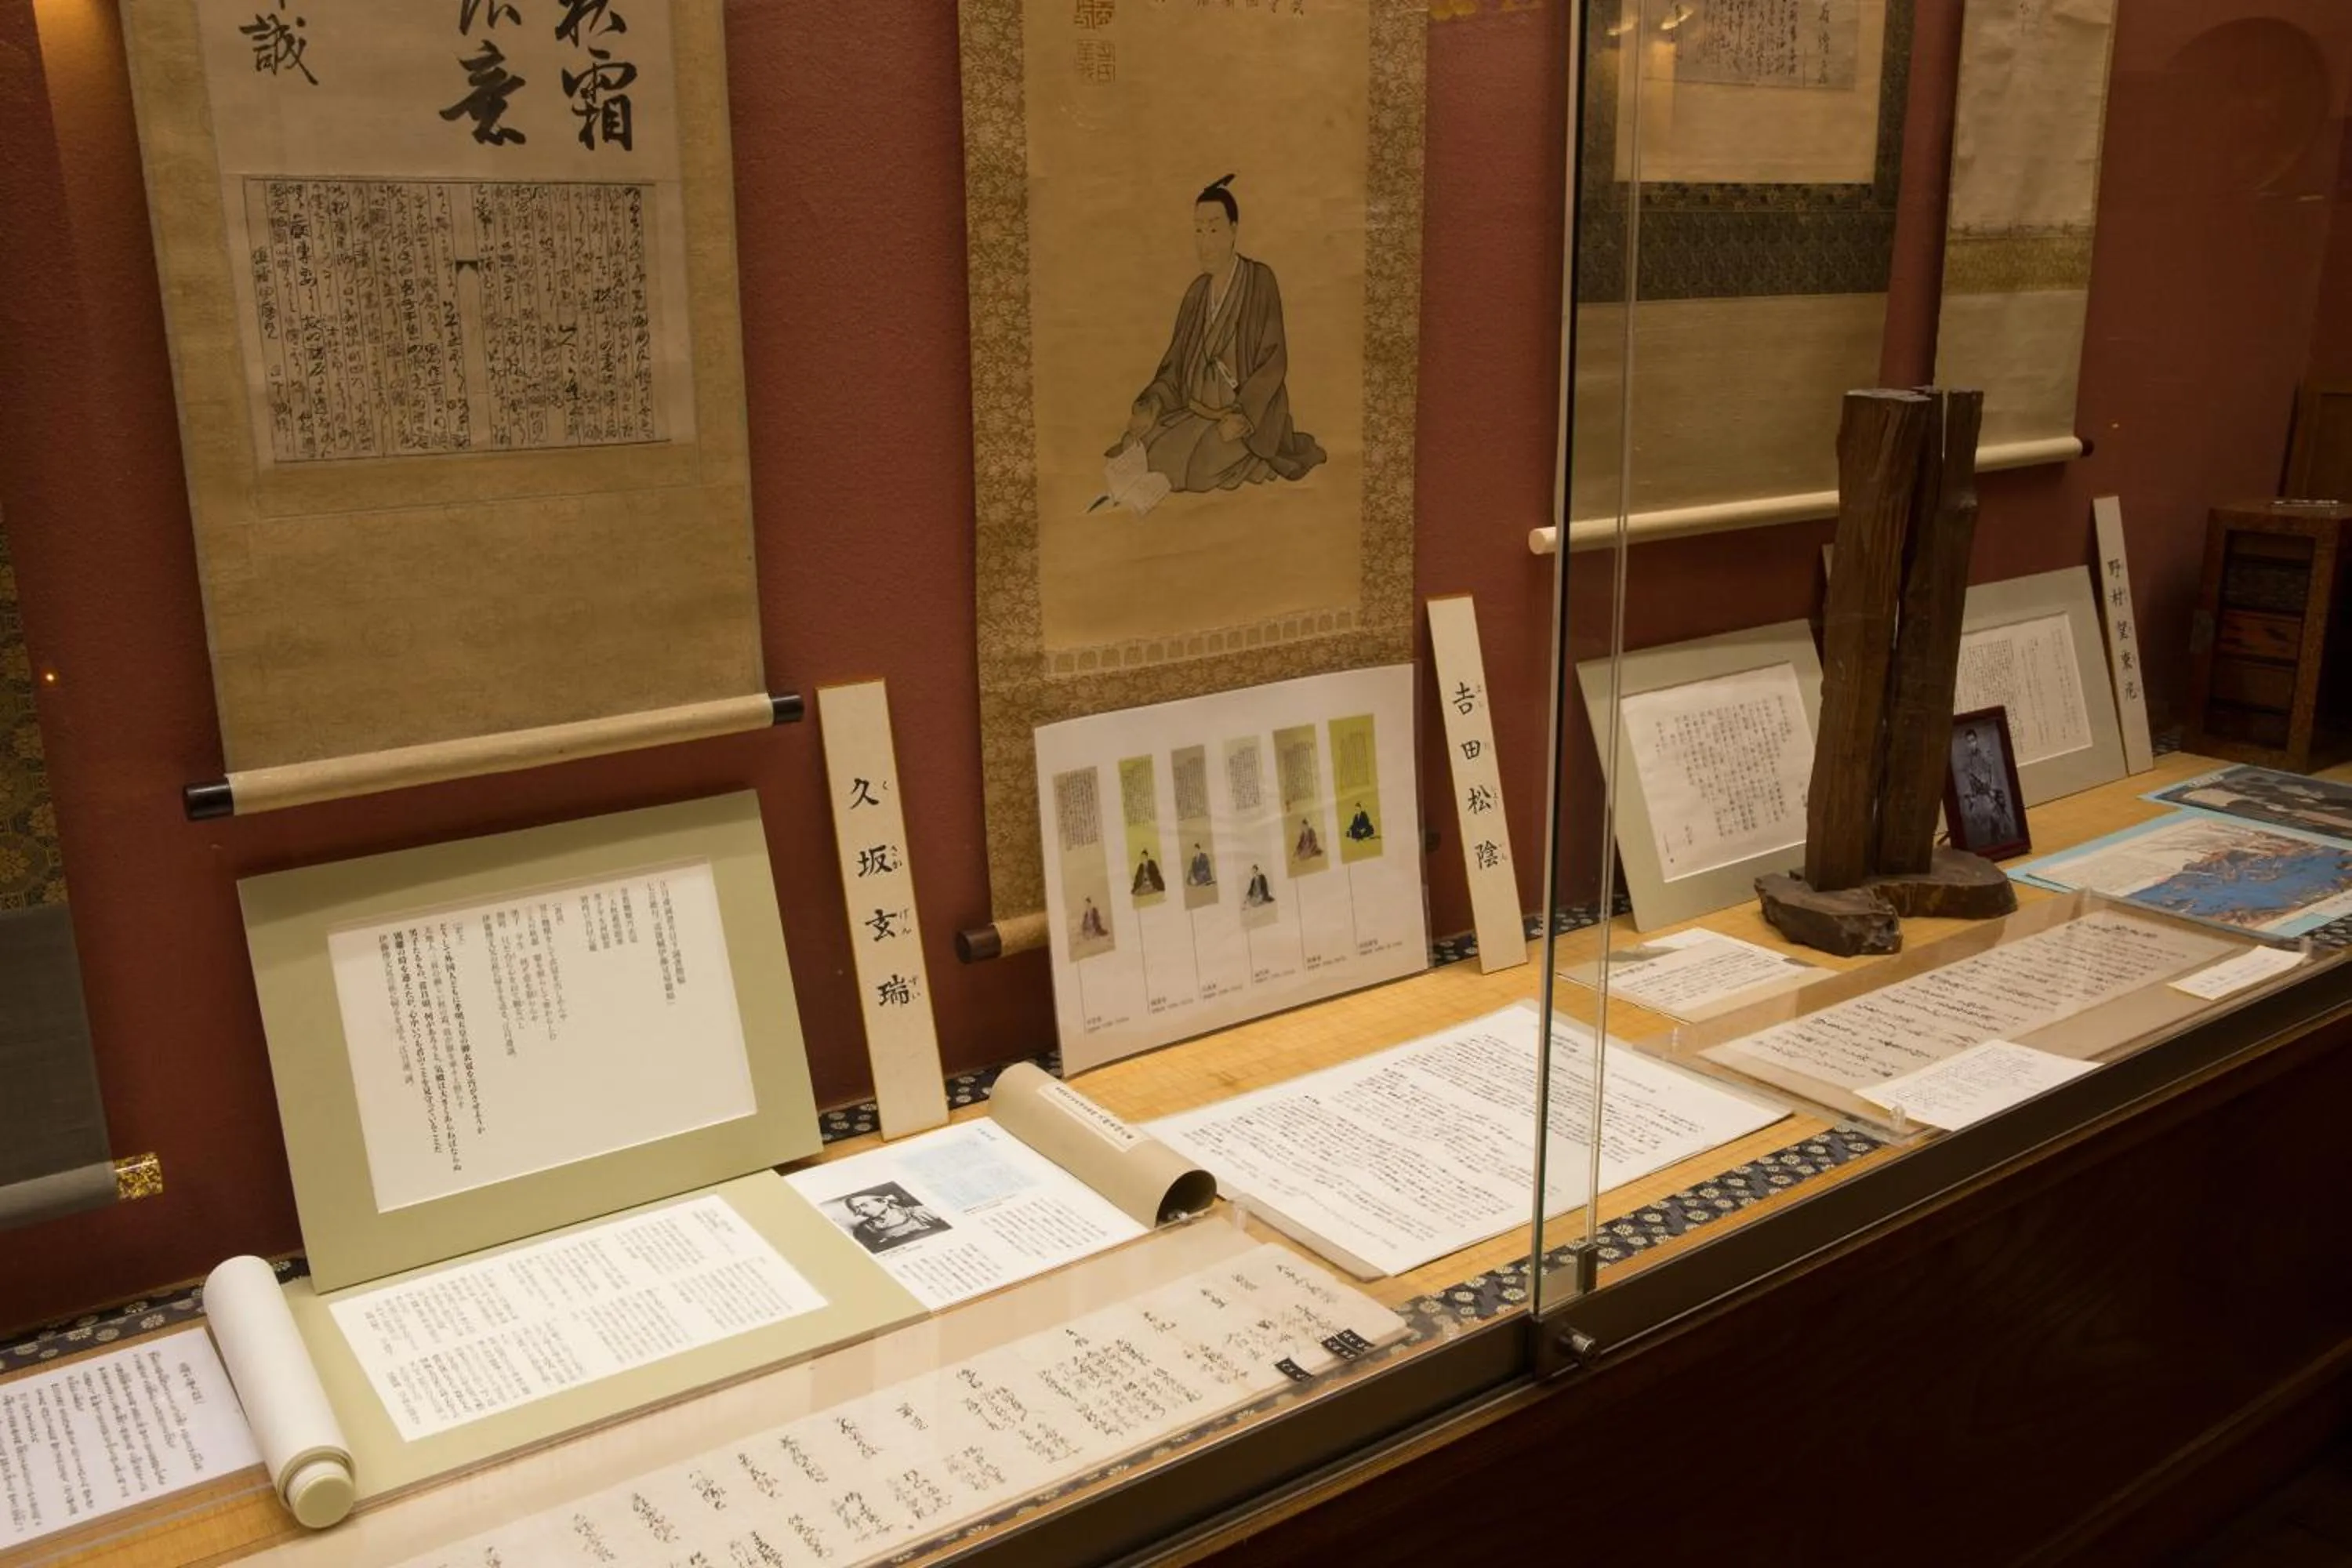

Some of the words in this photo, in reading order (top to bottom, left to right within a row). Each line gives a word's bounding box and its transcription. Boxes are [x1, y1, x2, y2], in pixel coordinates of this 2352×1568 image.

[1452, 681, 1498, 870] 吉田松陰
[849, 777, 909, 1008] 久坂玄瑞
